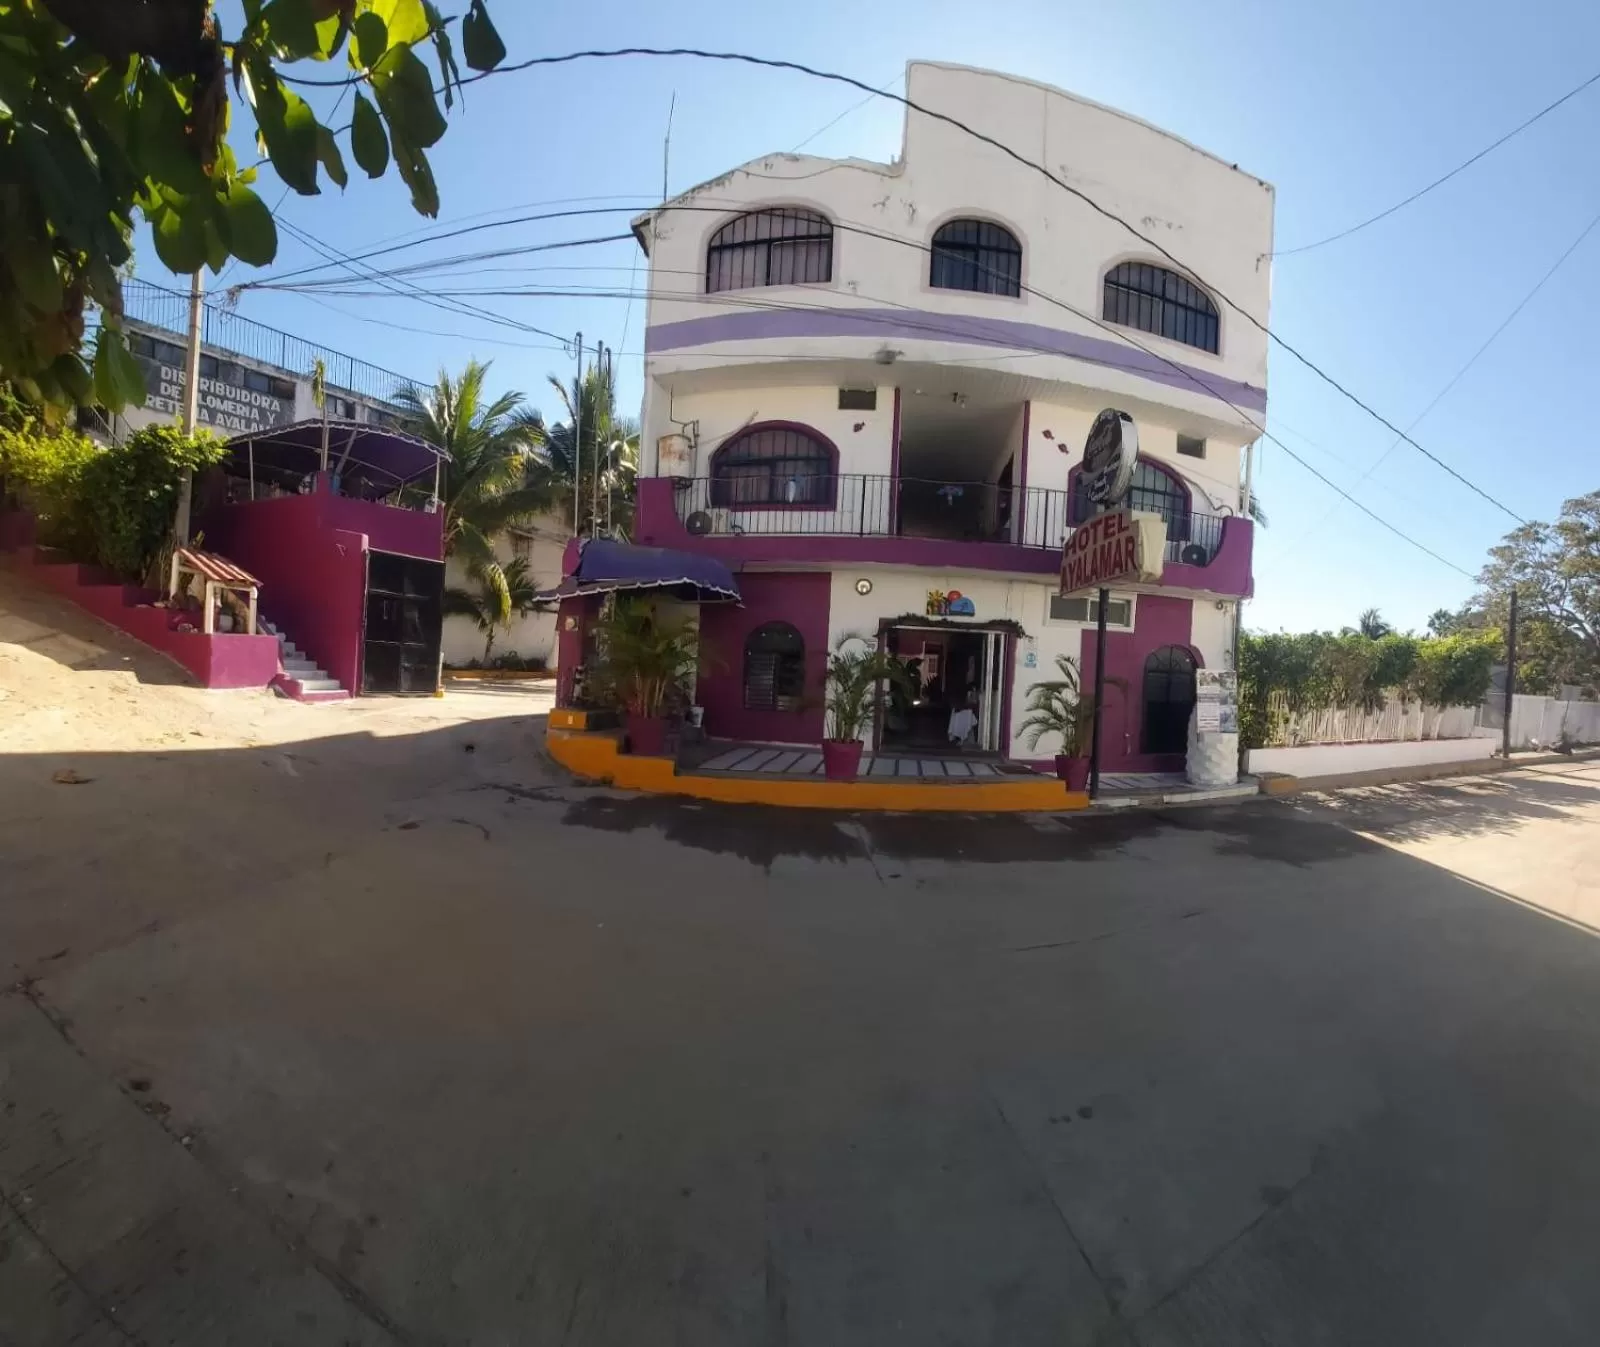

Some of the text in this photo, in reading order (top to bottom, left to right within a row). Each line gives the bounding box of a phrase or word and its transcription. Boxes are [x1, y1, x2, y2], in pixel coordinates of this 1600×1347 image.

[160, 382, 182, 399] DE
[161, 365, 280, 412] DISRIBUIDORA
[195, 391, 276, 425] LOMERIA Y
[1064, 513, 1130, 559] HOTEL
[1061, 536, 1138, 594] AYALAMAR
